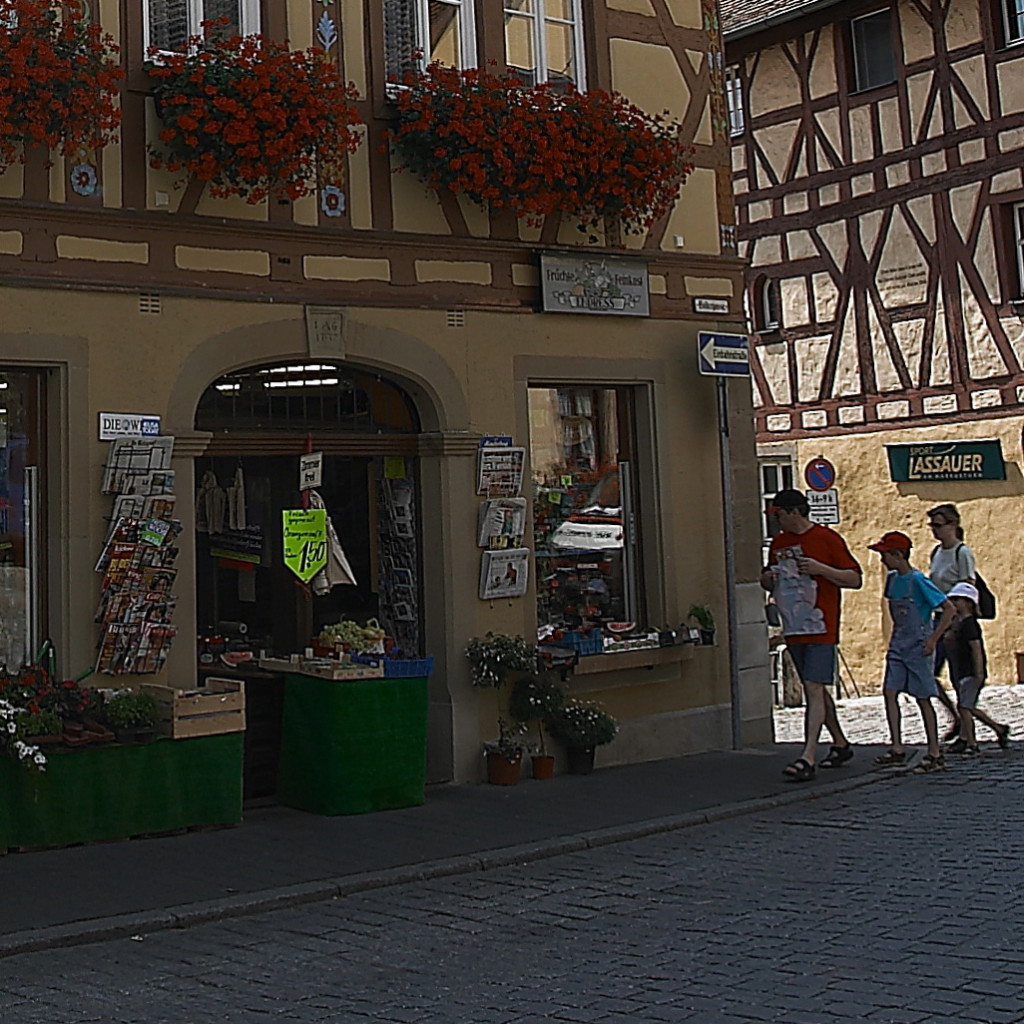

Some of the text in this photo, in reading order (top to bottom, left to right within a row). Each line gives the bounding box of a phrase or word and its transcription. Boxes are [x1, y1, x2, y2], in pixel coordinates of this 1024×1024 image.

[103, 418, 122, 430] DIE
[909, 446, 934, 456] SPORT
[908, 454, 984, 480] LASSAUER
